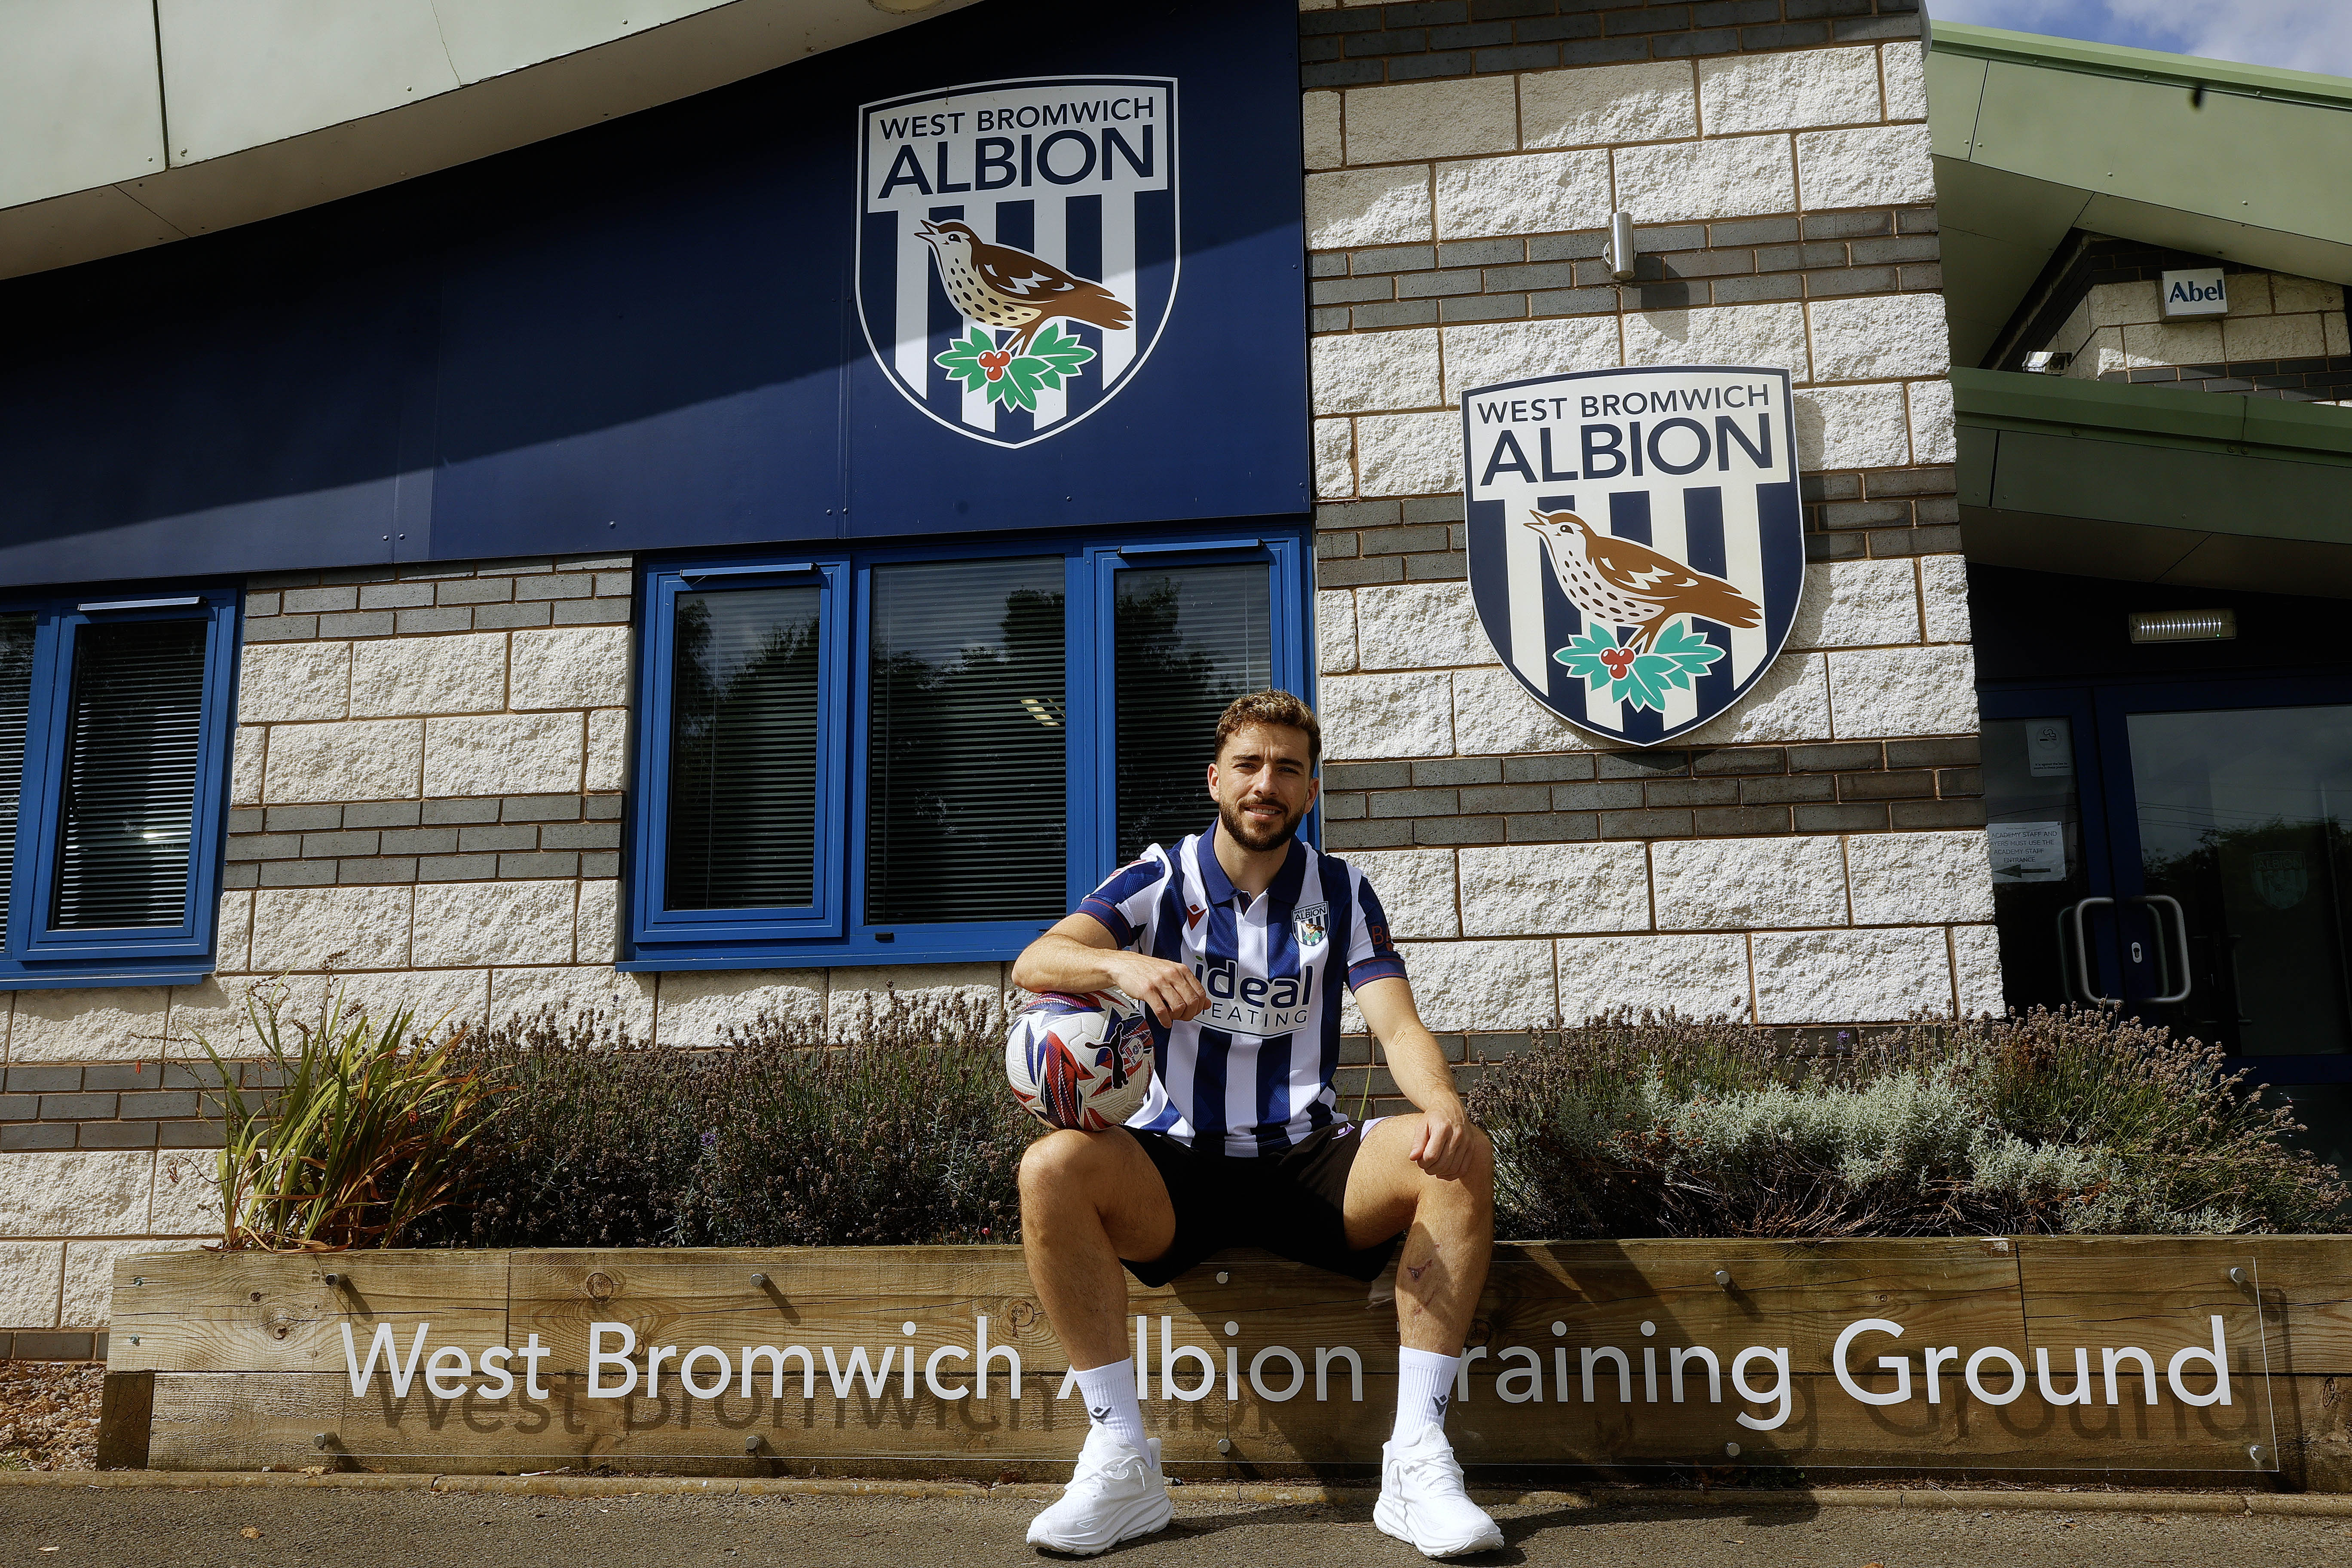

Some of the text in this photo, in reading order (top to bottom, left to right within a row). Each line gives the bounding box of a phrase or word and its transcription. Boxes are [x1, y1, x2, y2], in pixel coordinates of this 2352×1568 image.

[880, 96, 1154, 140] WEST BROMWICH
[877, 124, 1154, 199] ALBION
[2169, 279, 2224, 303] Abel
[1477, 384, 1769, 424] WEST BROMWICH
[1480, 413, 1773, 486] ALBION
[2258, 859, 2302, 869] ALBION
[1295, 907, 1326, 921] ALBION
[1195, 955, 1313, 1008] ideal
[1202, 1002, 1308, 1027] EATING
[340, 1323, 550, 1399] West
[588, 1316, 1021, 1400] Bromwich
[1397, 1321, 1792, 1430] raining
[1833, 1315, 2231, 1406] Ground
